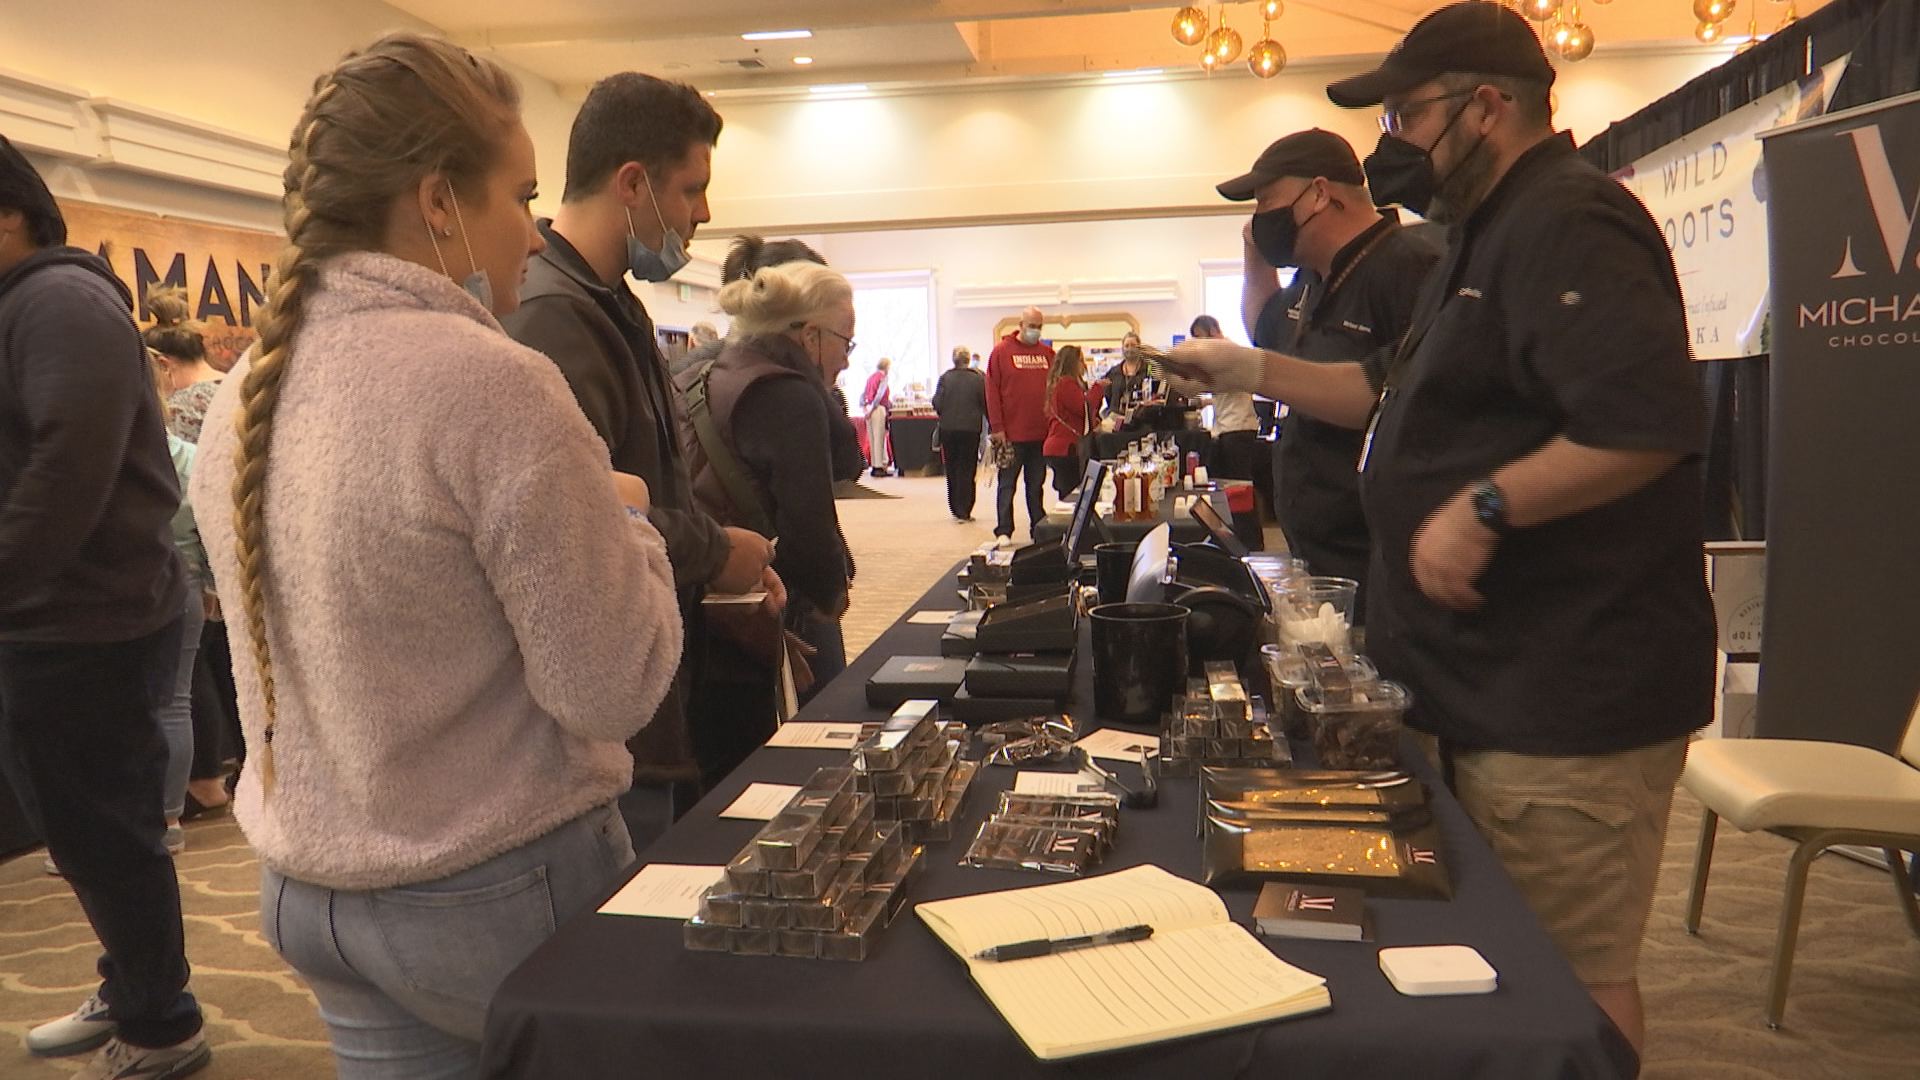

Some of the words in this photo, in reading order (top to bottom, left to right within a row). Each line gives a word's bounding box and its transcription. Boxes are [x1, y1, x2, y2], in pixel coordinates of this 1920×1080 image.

[1663, 141, 1727, 198] WILD
[1664, 198, 1734, 252] OOTS
[1012, 354, 1048, 364] INDIANA
